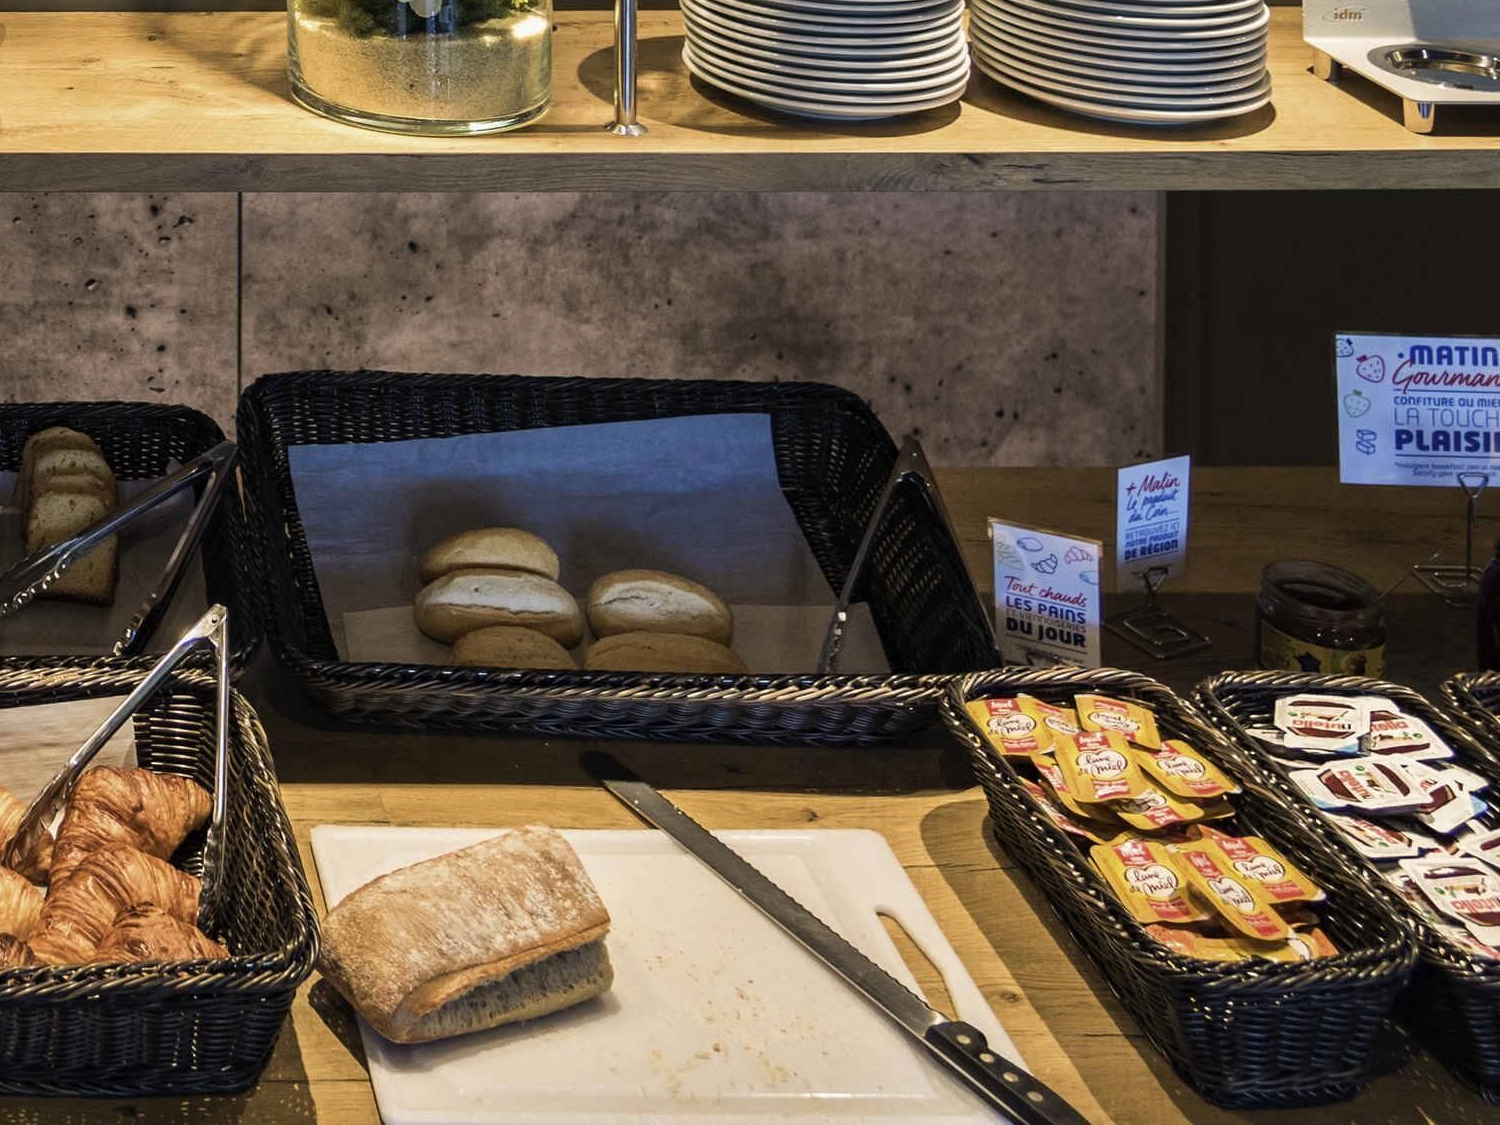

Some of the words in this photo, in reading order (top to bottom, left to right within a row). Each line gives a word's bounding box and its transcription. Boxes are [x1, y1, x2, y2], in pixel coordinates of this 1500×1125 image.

[1409, 344, 1499, 367] MATIN
[1393, 395, 1454, 408] CONFITURE
[1458, 397, 1474, 408] OU
[1394, 407, 1420, 427] LA
[1124, 548, 1137, 561] DE
[1140, 538, 1179, 556] RÉGION
[1004, 575, 1038, 596] Tout
[1039, 586, 1088, 608] chauds
[1005, 595, 1033, 612] LES
[1038, 602, 1086, 625] PAINS
[1005, 617, 1033, 635] DU
[1037, 624, 1086, 648] JOUR
[1291, 719, 1352, 731] nutella
